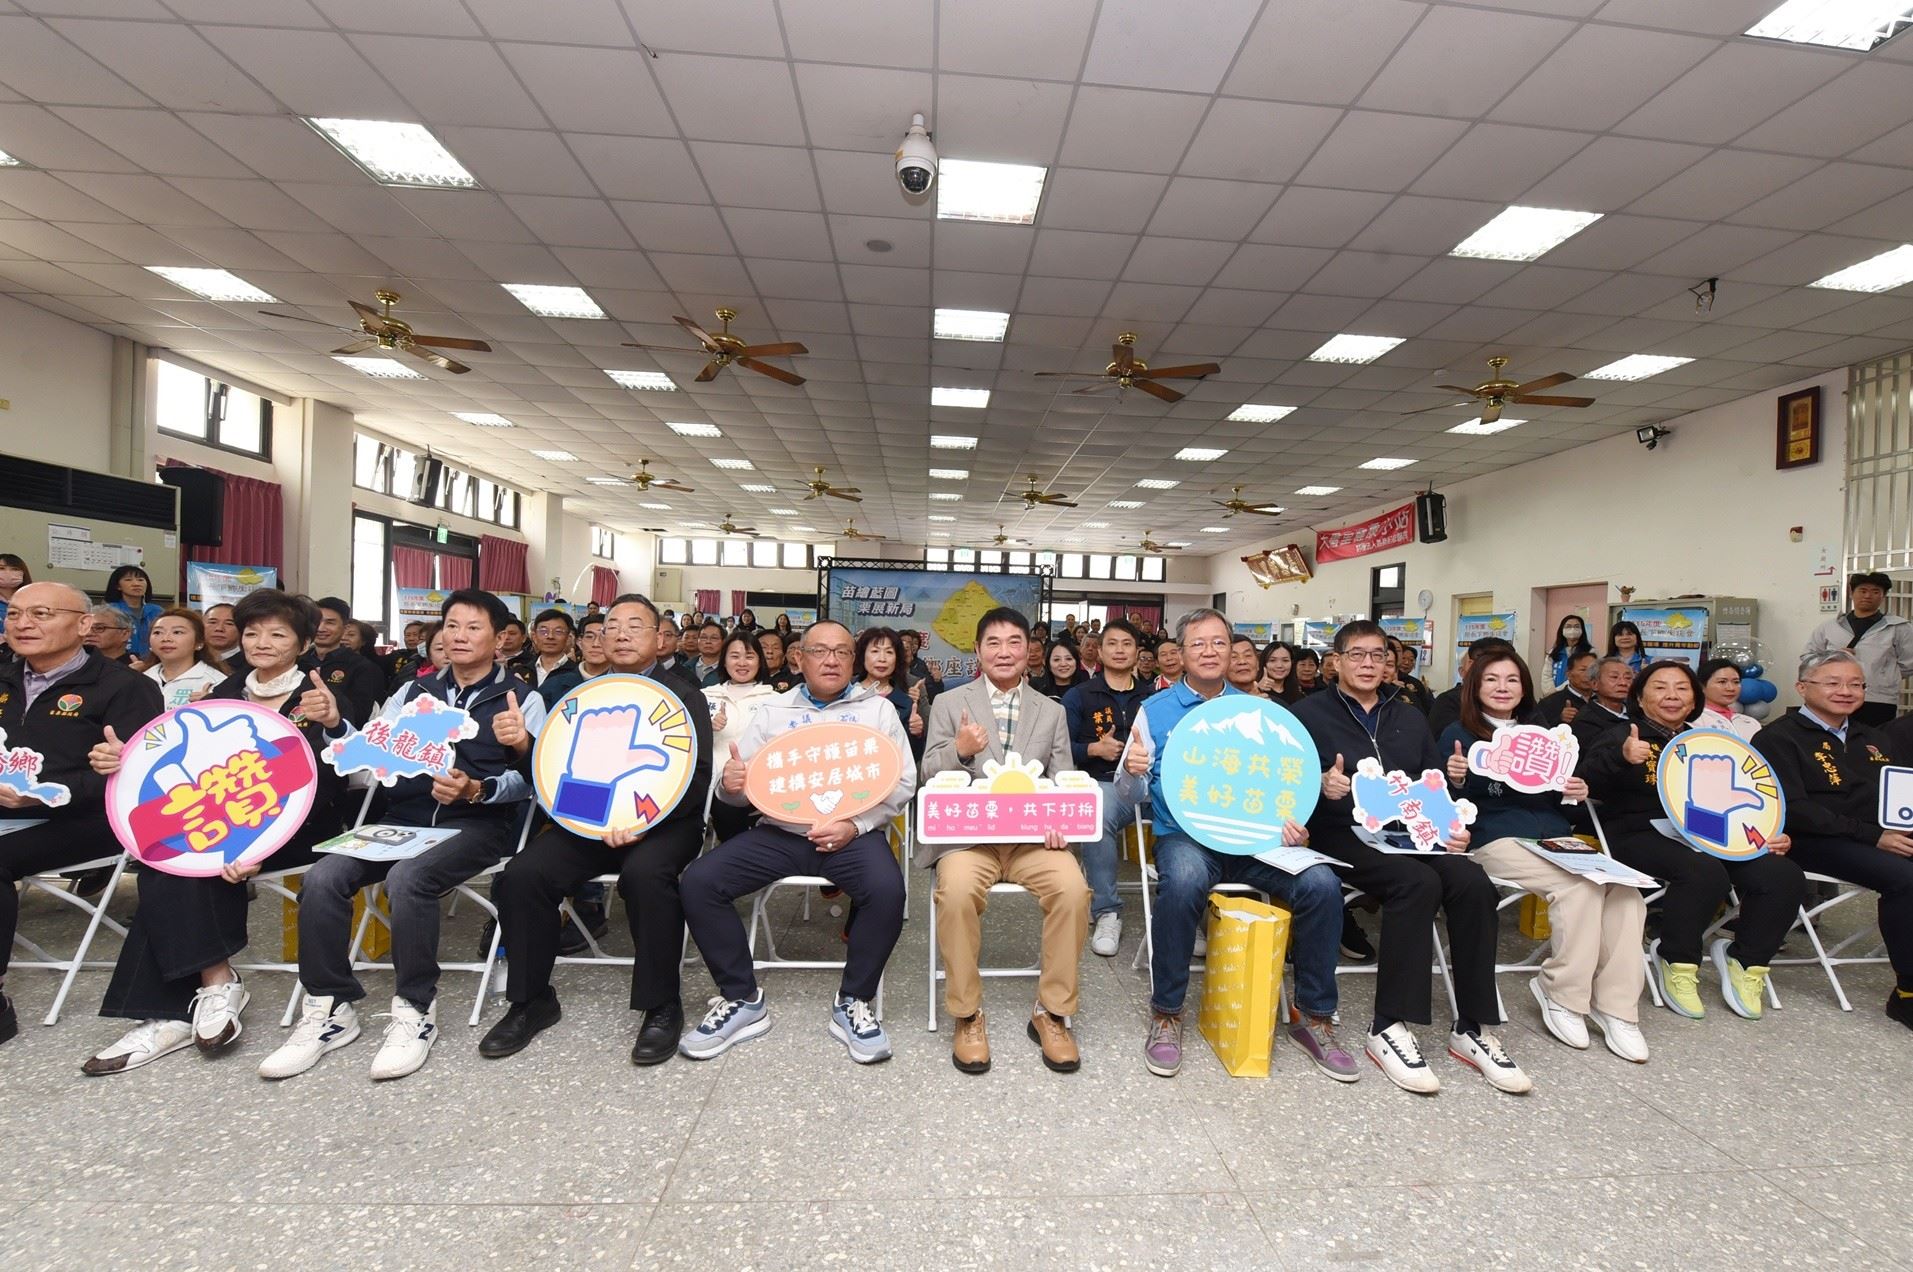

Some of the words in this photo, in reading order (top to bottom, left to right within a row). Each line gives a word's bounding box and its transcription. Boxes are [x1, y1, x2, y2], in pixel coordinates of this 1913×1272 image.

[841, 586, 899, 600] 苗繪藍圖
[857, 601, 914, 616] 栗展新局
[365, 720, 447, 769] 後龍鎮
[767, 737, 879, 769] 攜手守護苗栗
[769, 763, 881, 794] 建構安居城市
[1183, 746, 1304, 785] 山海共榮
[160, 750, 282, 852] 讚
[1179, 774, 1297, 820] 美好苗栗
[1387, 774, 1440, 848] 竹南鎮
